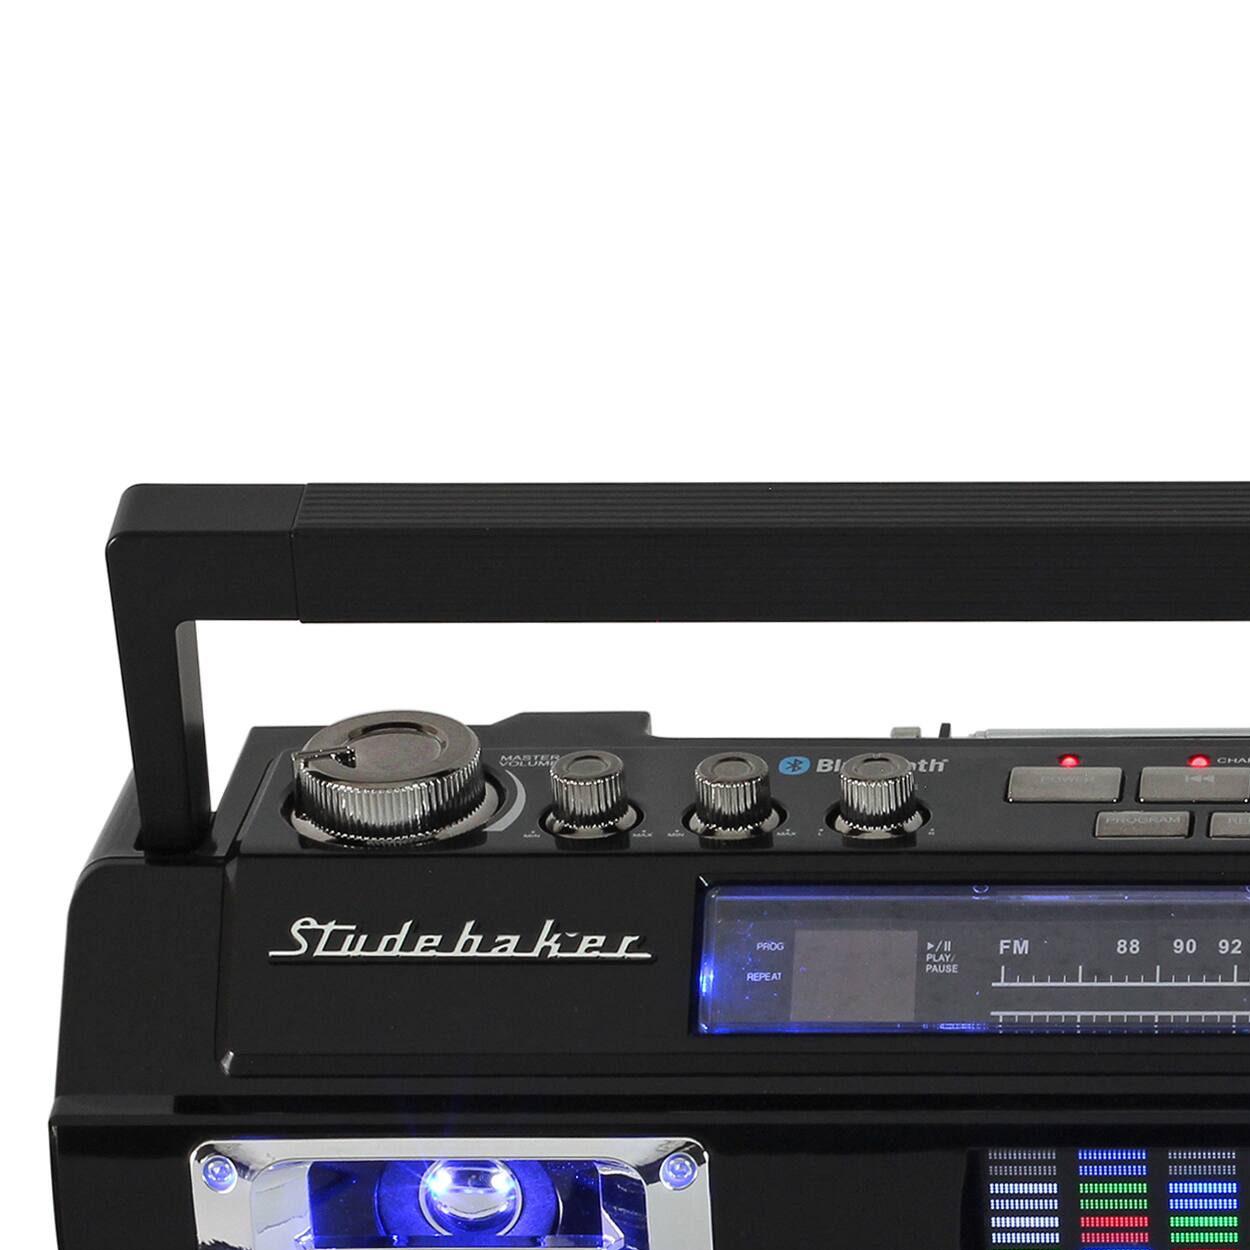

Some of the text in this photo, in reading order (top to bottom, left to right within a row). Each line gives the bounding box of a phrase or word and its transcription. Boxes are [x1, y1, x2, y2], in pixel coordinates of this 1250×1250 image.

[1106, 815, 1182, 824] PROGRAM
[268, 915, 653, 959] Studebaker
[756, 942, 785, 951] PROG
[999, 939, 1030, 955] FM
[1116, 939, 1141, 955] 88
[1172, 939, 1198, 955] 90
[1218, 939, 1243, 955] 92
[925, 964, 959, 974] PAUSE
[746, 972, 782, 981] REPEAT
